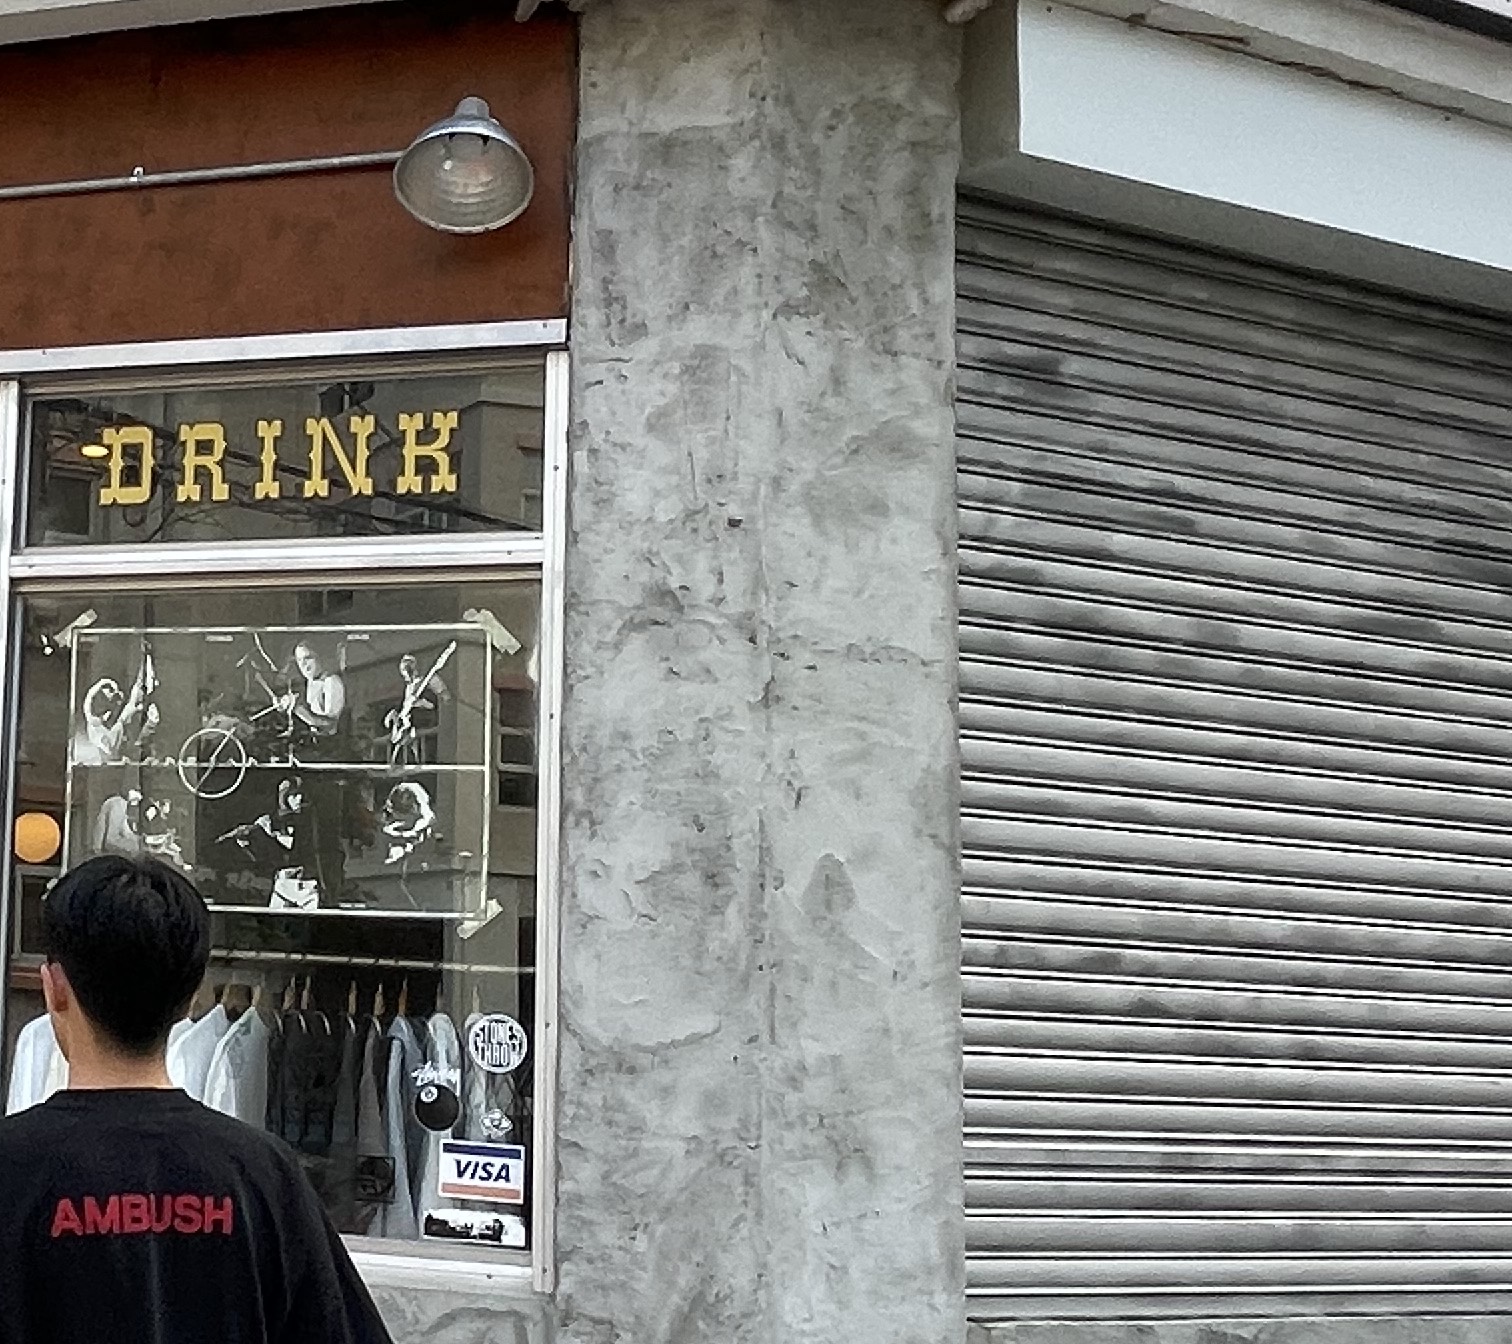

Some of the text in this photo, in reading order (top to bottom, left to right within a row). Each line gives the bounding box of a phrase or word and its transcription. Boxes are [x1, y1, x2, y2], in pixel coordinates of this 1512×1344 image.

[99, 409, 459, 507] DRINK
[454, 1158, 512, 1184] VISA
[51, 1191, 234, 1238] AMBUSH
